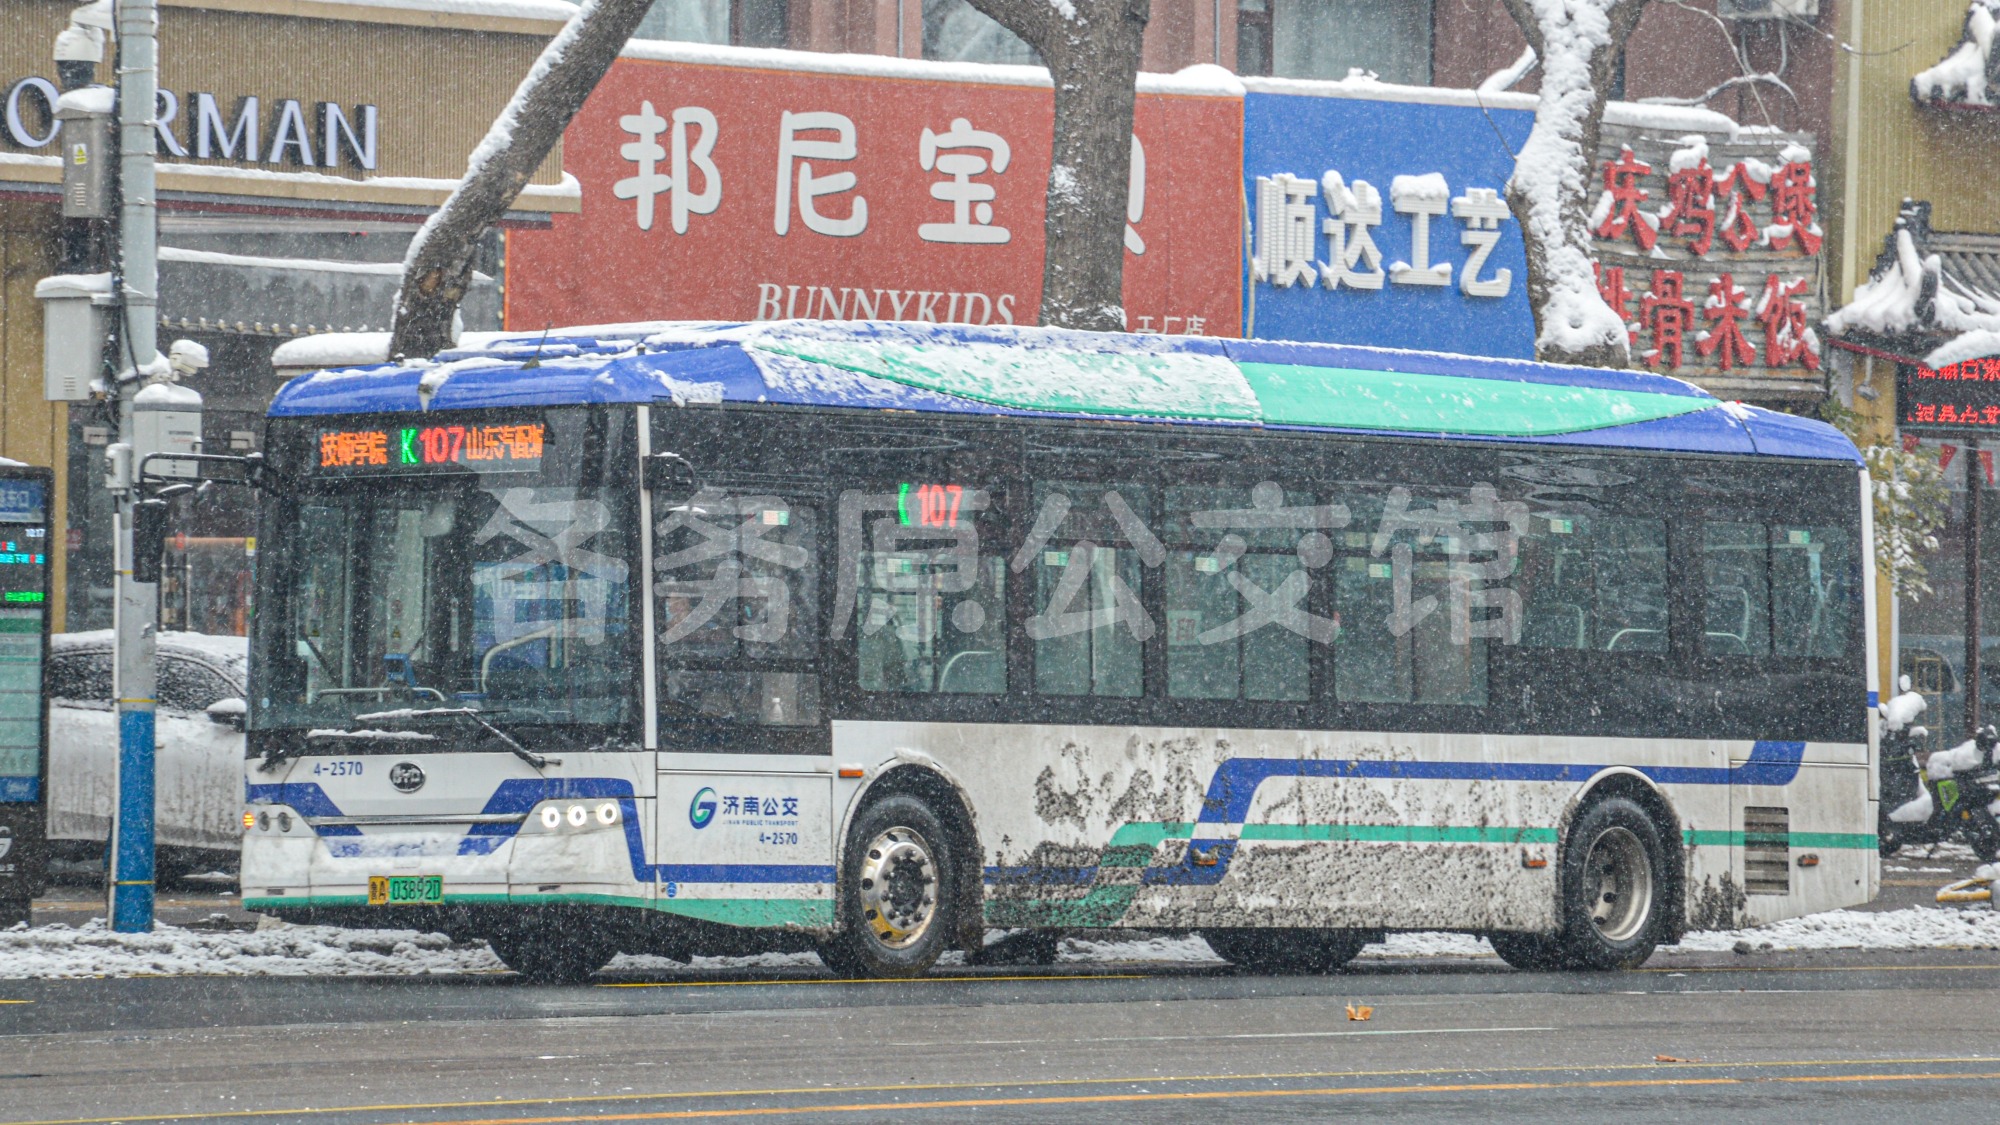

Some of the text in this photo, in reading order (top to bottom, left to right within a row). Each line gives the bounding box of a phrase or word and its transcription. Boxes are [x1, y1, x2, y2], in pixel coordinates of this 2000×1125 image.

[1254, 172, 1513, 297] 顺达工艺
[755, 283, 1015, 326] BUNNYKIDS
[1134, 314, 1206, 336] 工厂店
[313, 761, 363, 776] 4-2570
[723, 796, 798, 816] 济南公交
[759, 832, 798, 845] 4-2570
